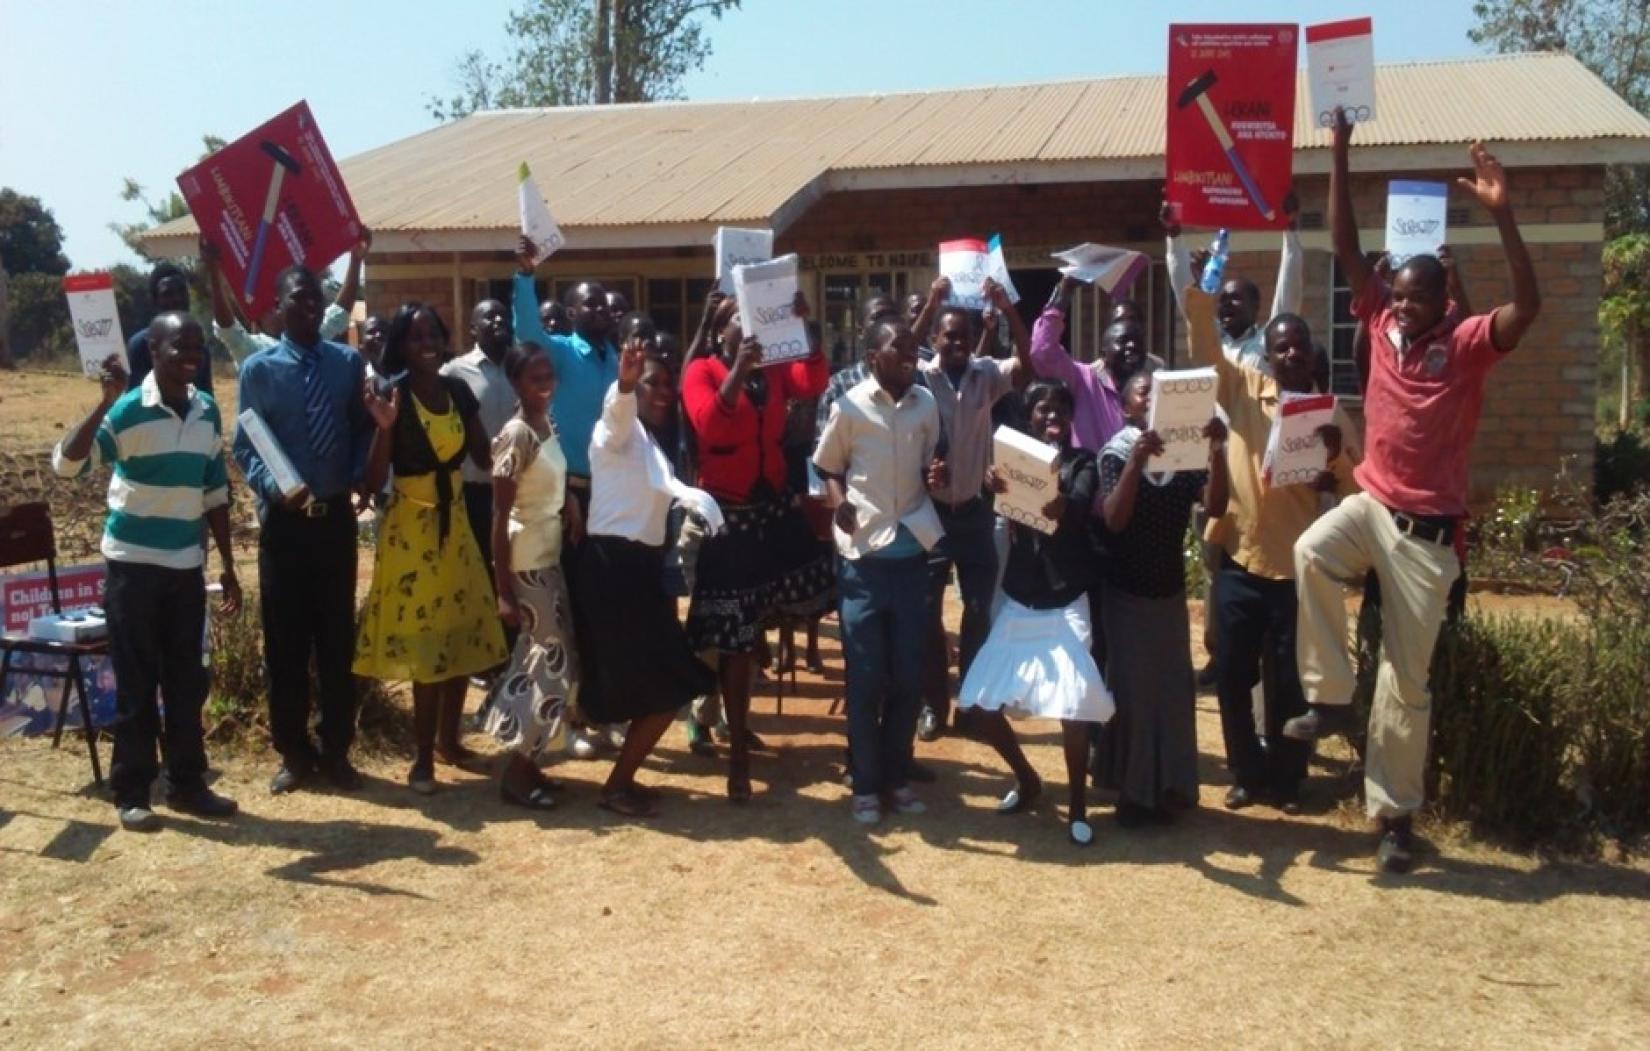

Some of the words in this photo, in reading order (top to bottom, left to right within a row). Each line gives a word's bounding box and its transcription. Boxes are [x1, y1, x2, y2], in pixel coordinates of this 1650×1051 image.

[798, 254, 857, 270] ELCOME
[79, 582, 94, 597] in
[11, 607, 34, 624] not
